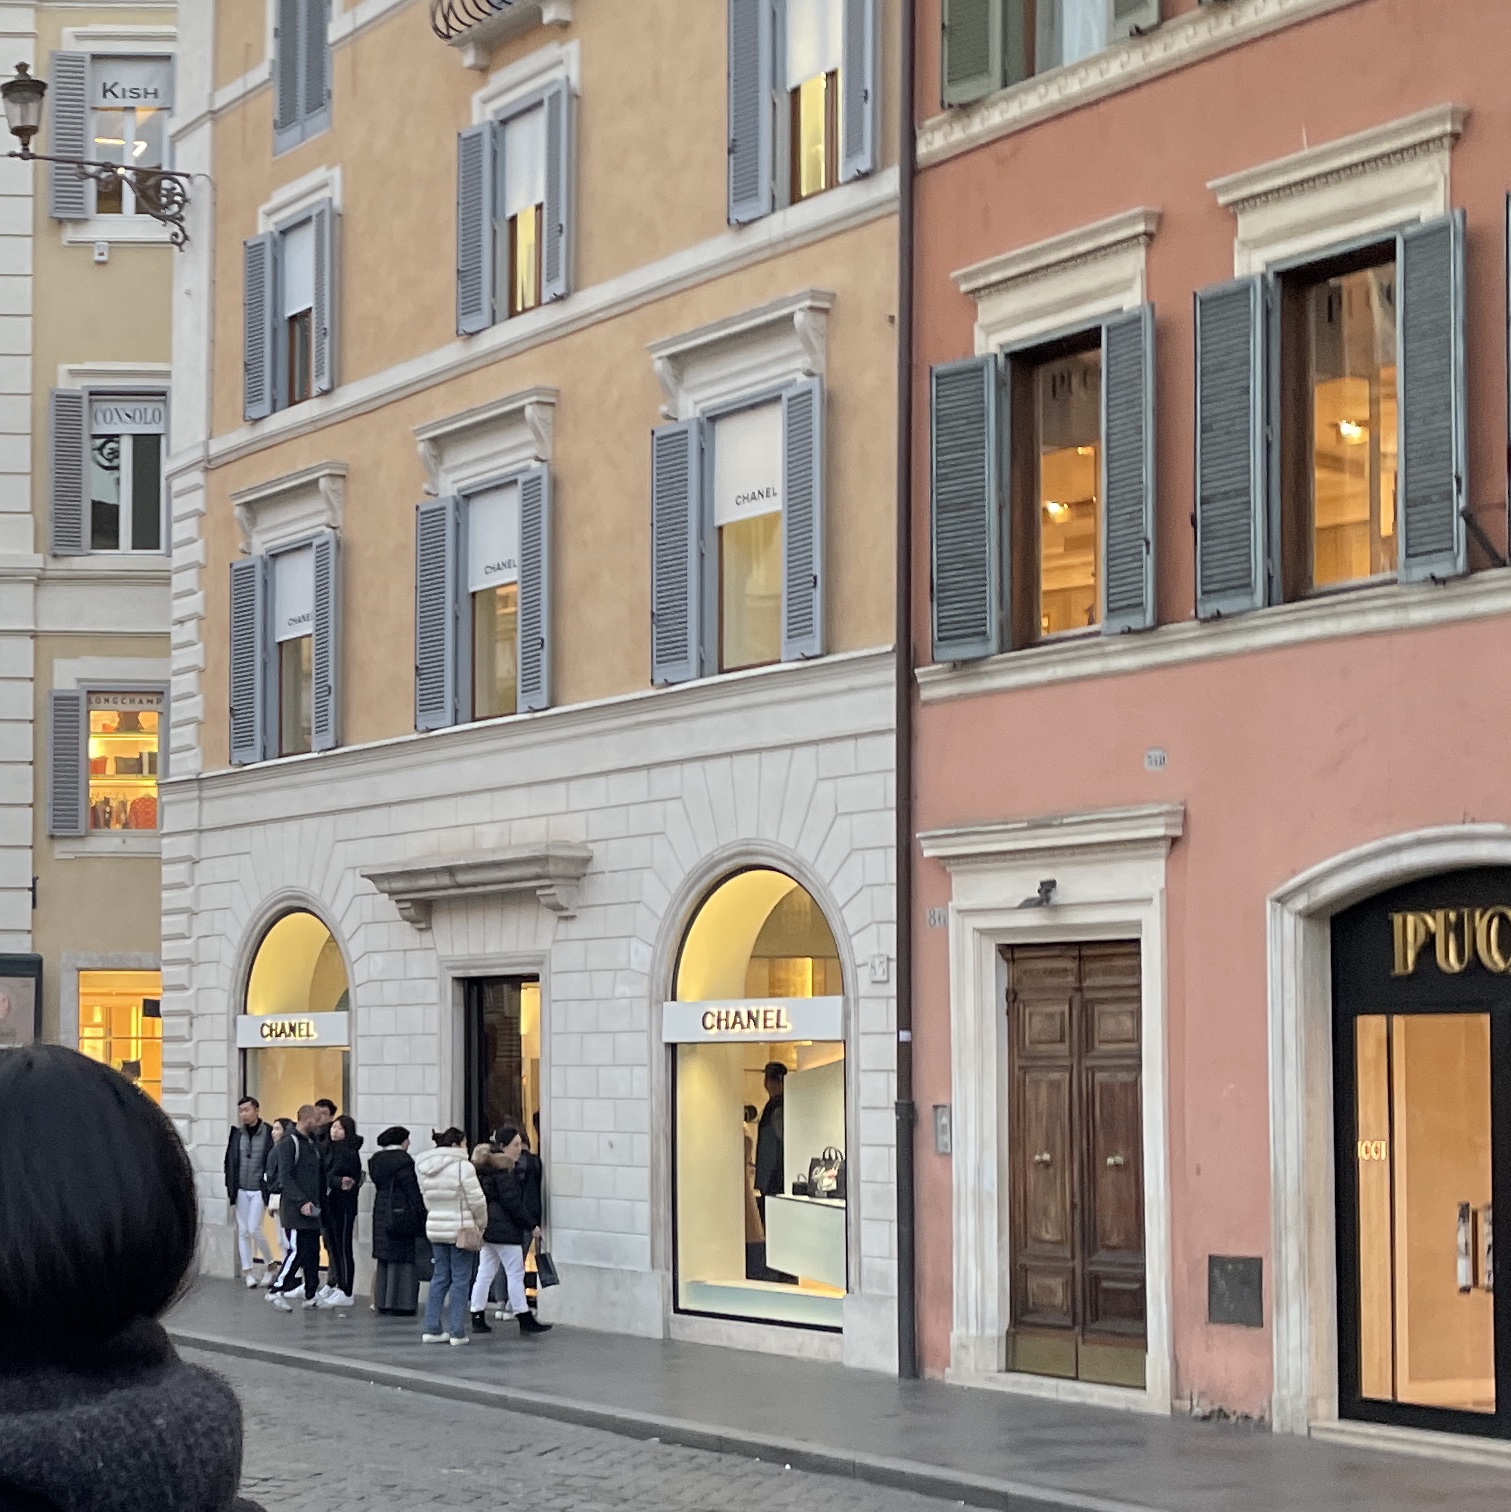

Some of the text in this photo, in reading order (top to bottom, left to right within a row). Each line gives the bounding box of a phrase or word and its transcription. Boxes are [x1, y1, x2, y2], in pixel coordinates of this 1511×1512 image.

[94, 407, 162, 425] CONSOLO
[735, 487, 778, 506] CHANEL
[484, 558, 518, 575] CHANEL
[287, 612, 313, 627] CHANE
[88, 696, 162, 705] LONGCHAMP
[928, 907, 947, 929] 86
[701, 1008, 788, 1031] CHANEL
[260, 1021, 314, 1039] CHANEL
